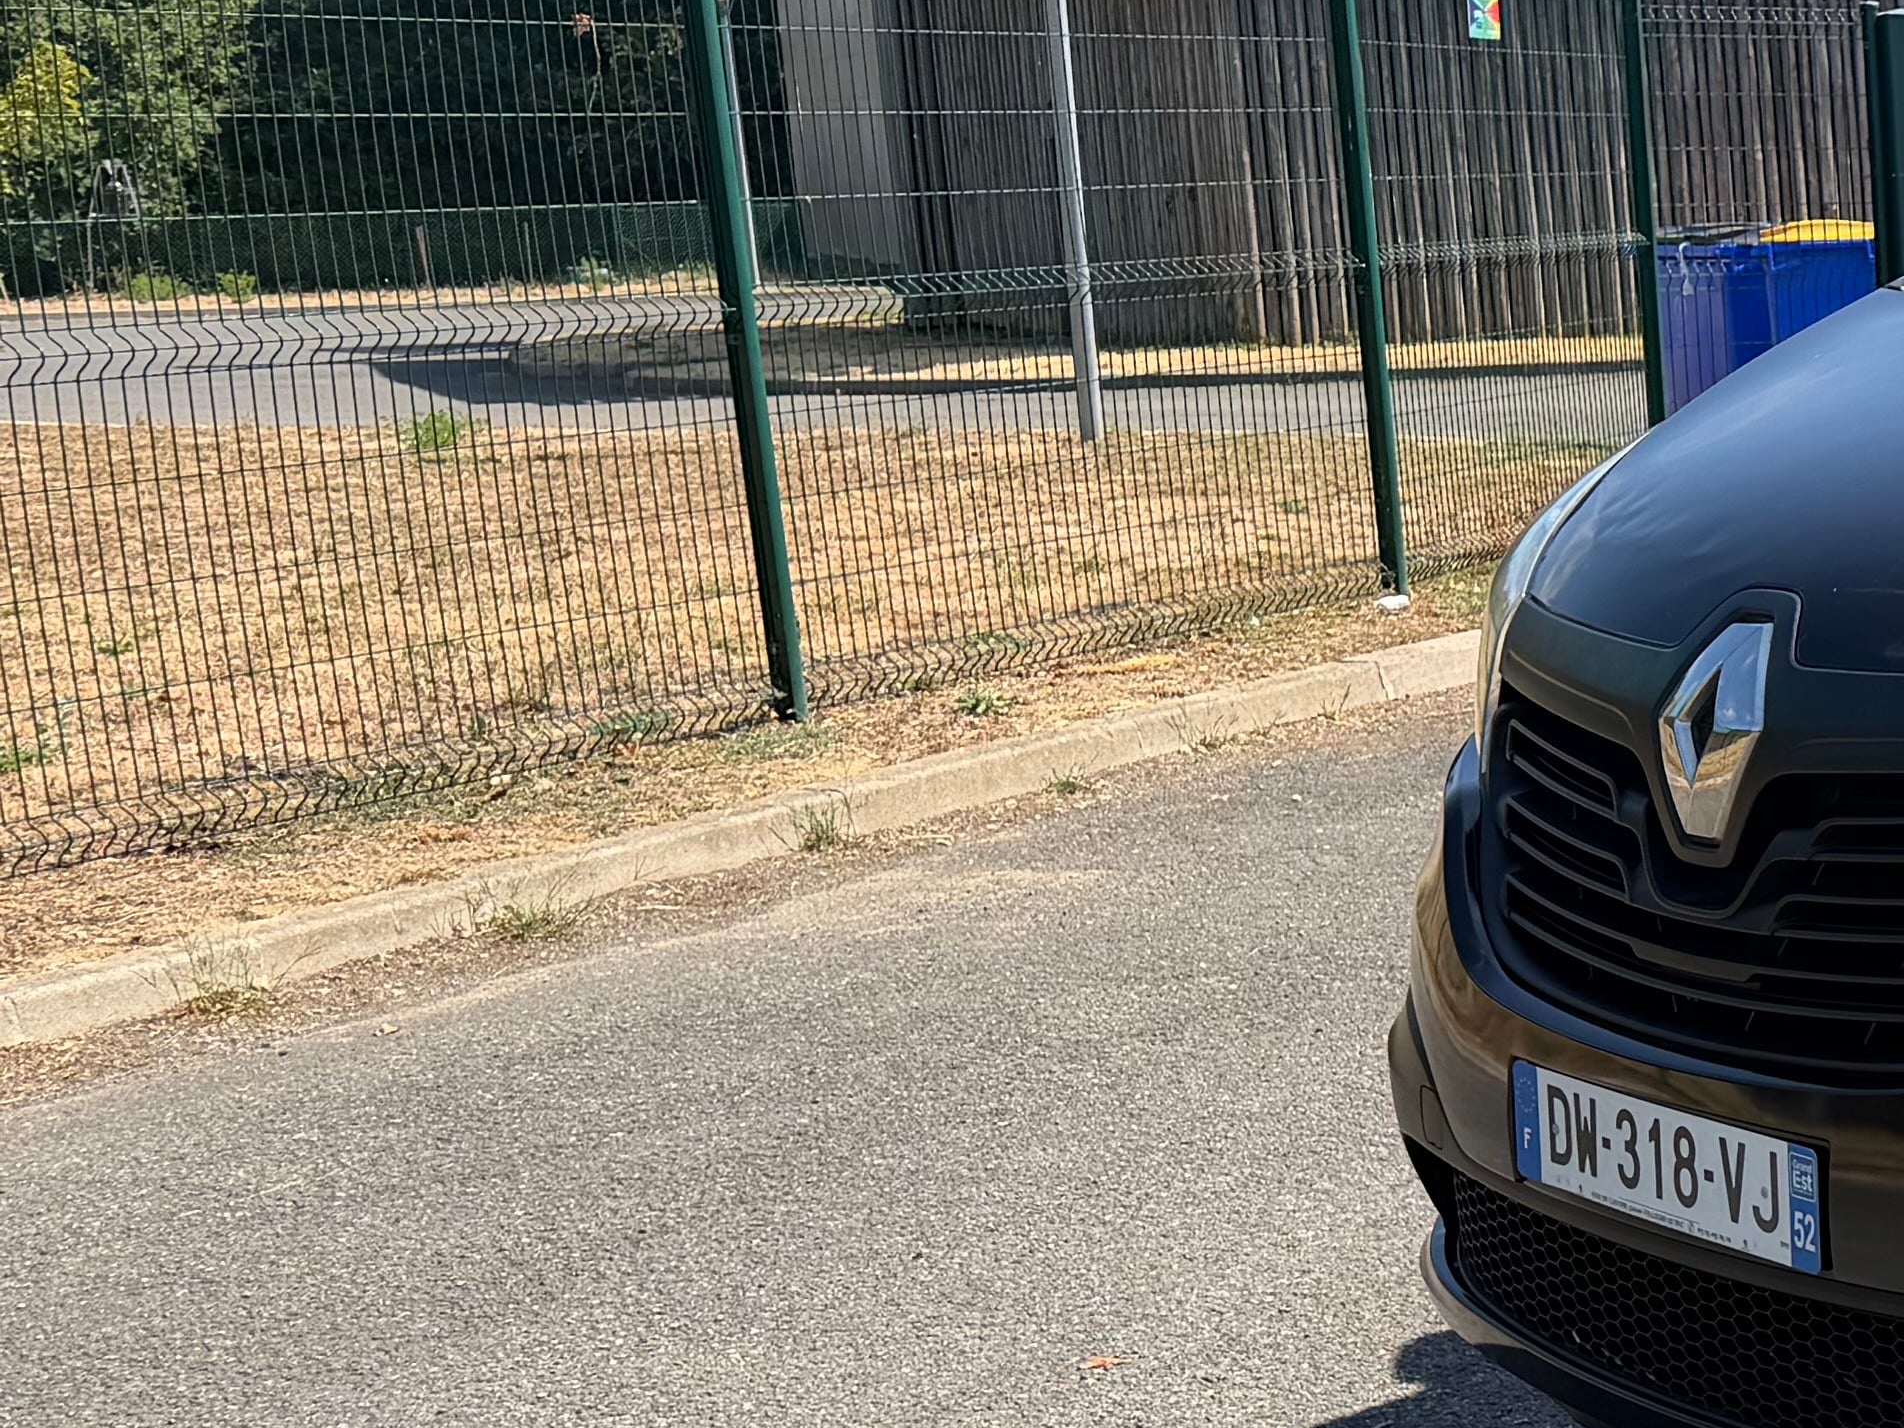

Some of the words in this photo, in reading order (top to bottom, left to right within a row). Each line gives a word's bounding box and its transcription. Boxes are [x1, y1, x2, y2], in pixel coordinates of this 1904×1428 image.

[1524, 1127, 1532, 1149] F
[1547, 1084, 1779, 1233] DW-318-VJ
[1792, 1170, 1812, 1192] Est
[1794, 1210, 1816, 1252] 52
